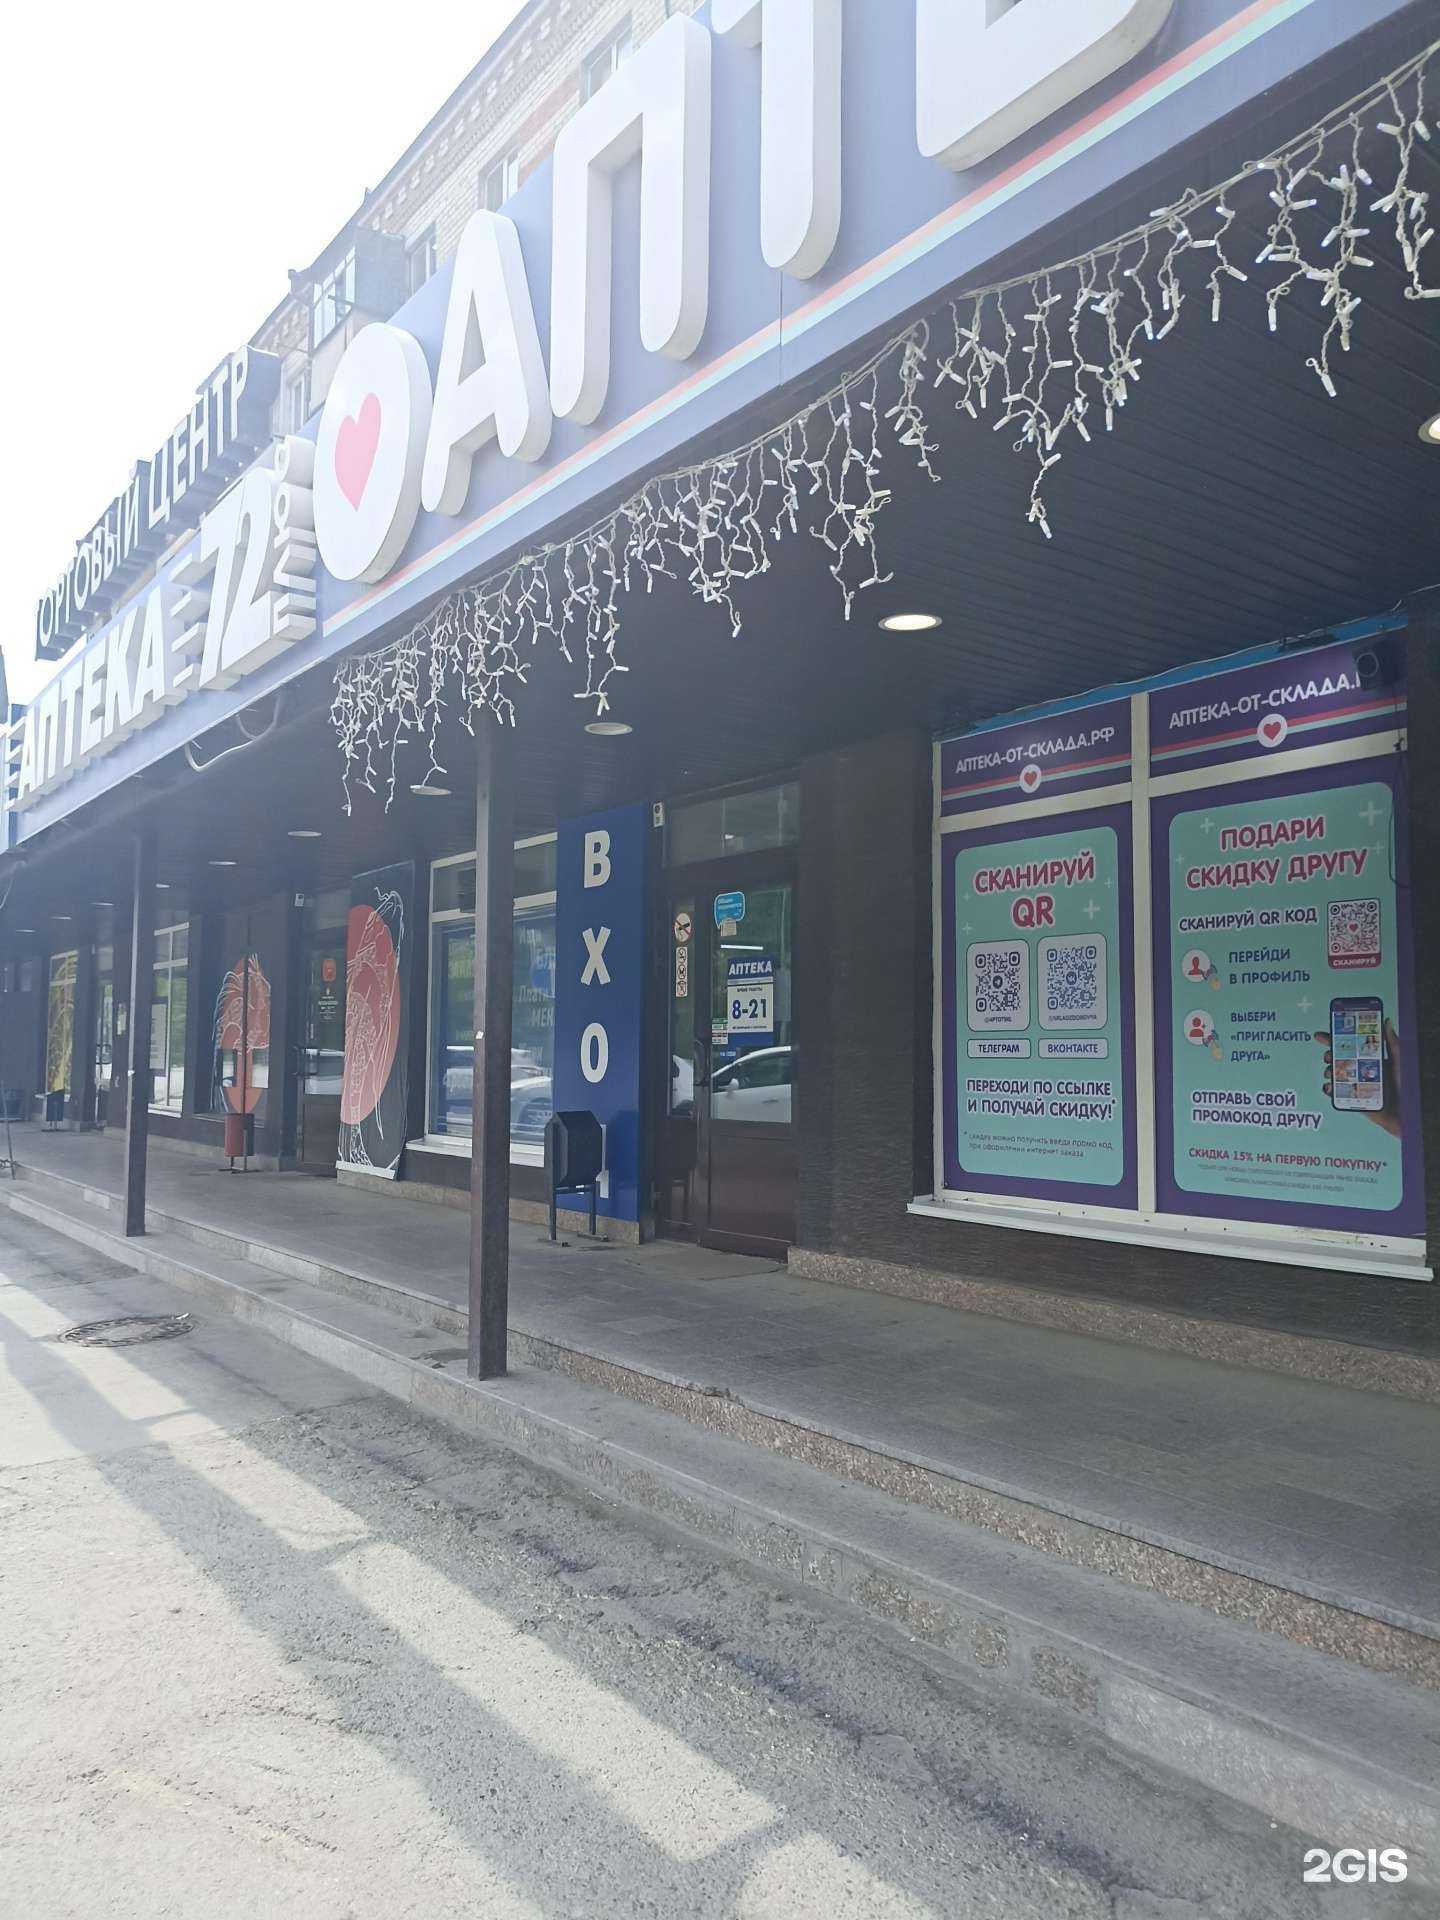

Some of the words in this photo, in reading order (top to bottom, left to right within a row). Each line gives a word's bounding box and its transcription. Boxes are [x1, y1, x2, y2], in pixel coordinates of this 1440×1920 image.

[149, 346, 248, 530] ЦЕНТР
[17, 585, 165, 801] АПТЕКА
[199, 465, 275, 691] 72
[1169, 672, 1361, 729] АПТЕКА-ОТ-СКЛАДА.
[955, 726, 1115, 774] АПТЕКА-ОТ-СКЛАДА.РФ
[1220, 816, 1324, 850] ПОДАРИ
[974, 850, 1095, 893] СКАНИРУЙ
[1186, 858, 1280, 889] СКИДКУ
[1287, 848, 1368, 882] ДРУГУ
[1012, 895, 1054, 928] QR
[1178, 909, 1255, 932] СКАНИРУЙ
[1259, 911, 1280, 926] QR
[1285, 907, 1318, 924] КОД
[1228, 946, 1291, 963] ПЕРЕЙДИ
[728, 960, 774, 977] АПТЕКА
[1229, 973, 1238, 985] В
[1241, 970, 1311, 985] ПРОФИЛЬ
[580, 830, 612, 1198] ВХО
[731, 998, 769, 1020] 8-21
[1230, 1011, 1276, 1023] ВЫБЕРИ
[1231, 1030, 1312, 1042] «ПРИГЛАСИТЬ
[978, 1043, 1020, 1054] ТЕЛЕГРАМ
[1047, 1043, 1099, 1054] ВКОНТАКТЕ
[1231, 1050, 1270, 1063] ДРУГА»
[966, 1079, 1029, 1095] ПЕРЕХОДИ
[1033, 1081, 1053, 1095] ПО
[1056, 1081, 1112, 1096] ССЫЛКЕ
[967, 1099, 977, 1113] И
[981, 1098, 1045, 1117] ПОЛУЧАЙ
[1192, 1091, 1252, 1105] ОТПРАВЬ
[1256, 1090, 1296, 1107] СВОЙ
[1192, 1109, 1272, 1127] ПРОМОКОД
[1276, 1111, 1322, 1130] ДРУГУ
[1188, 1147, 1230, 1161] СКИДКА
[1233, 1149, 1253, 1163] 15%
[1256, 1152, 1272, 1164] НА
[1275, 1154, 1321, 1168] ПЕРВУЮ
